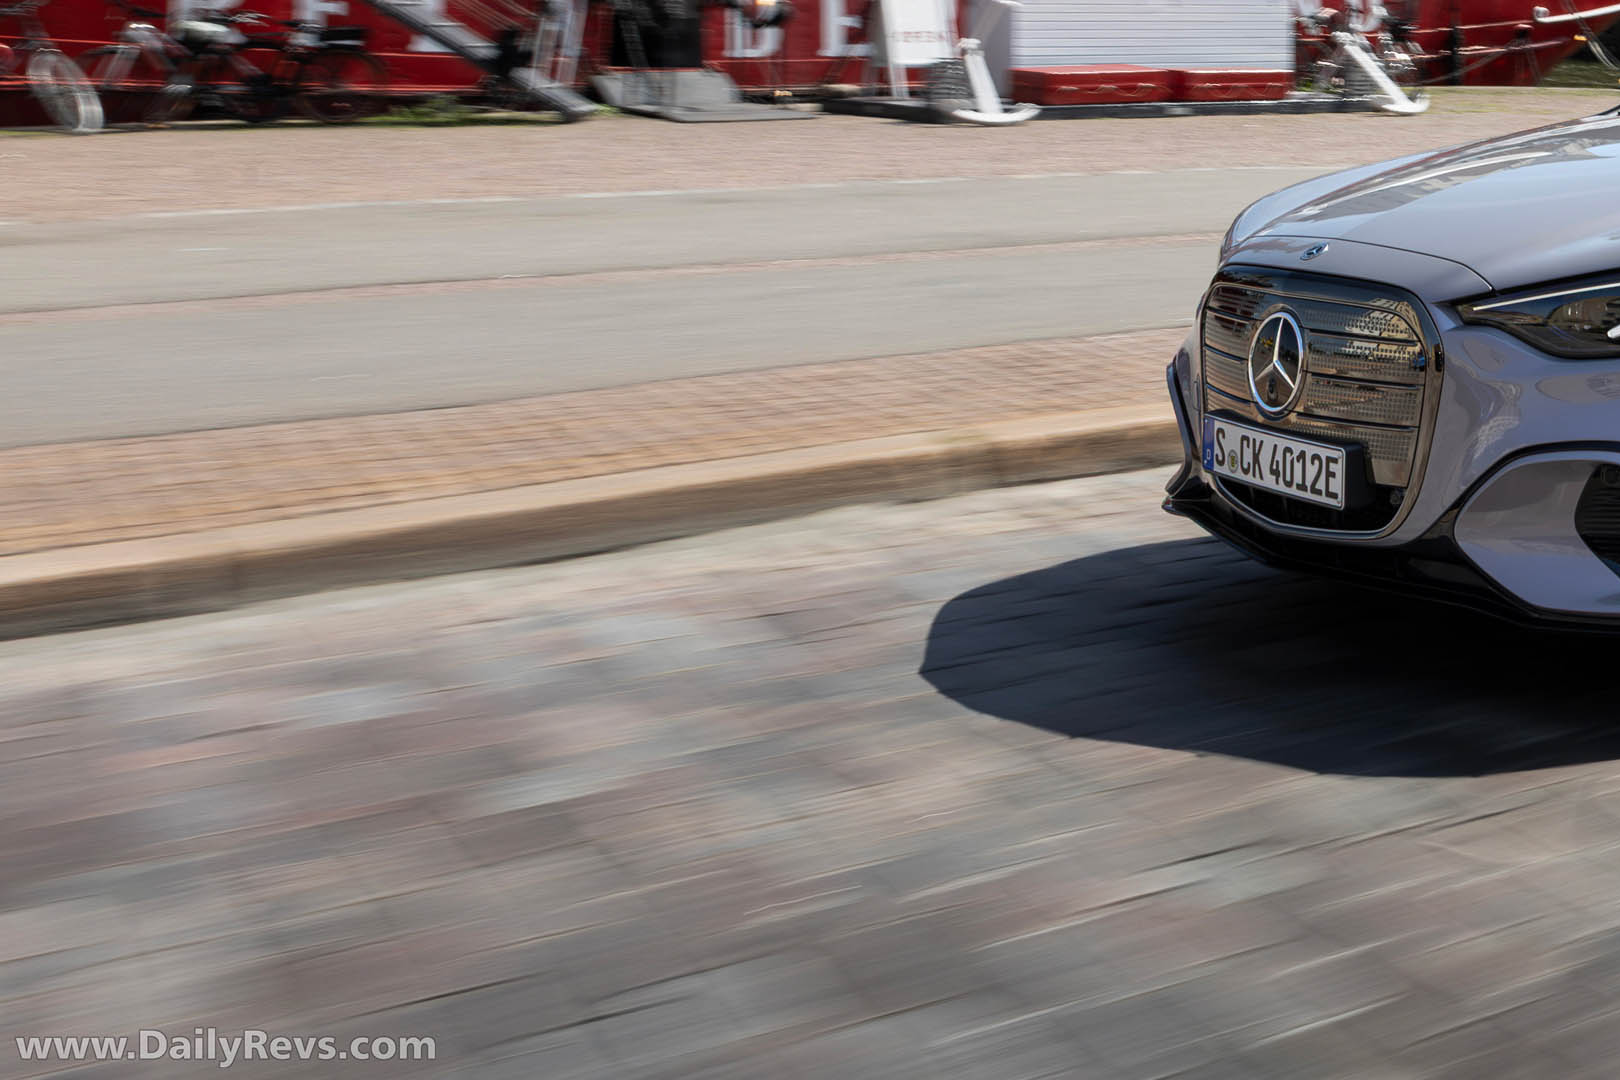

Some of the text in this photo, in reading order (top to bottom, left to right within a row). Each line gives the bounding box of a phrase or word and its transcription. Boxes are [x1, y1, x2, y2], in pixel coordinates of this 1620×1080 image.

[1215, 427, 1339, 500] S CK 4012E
